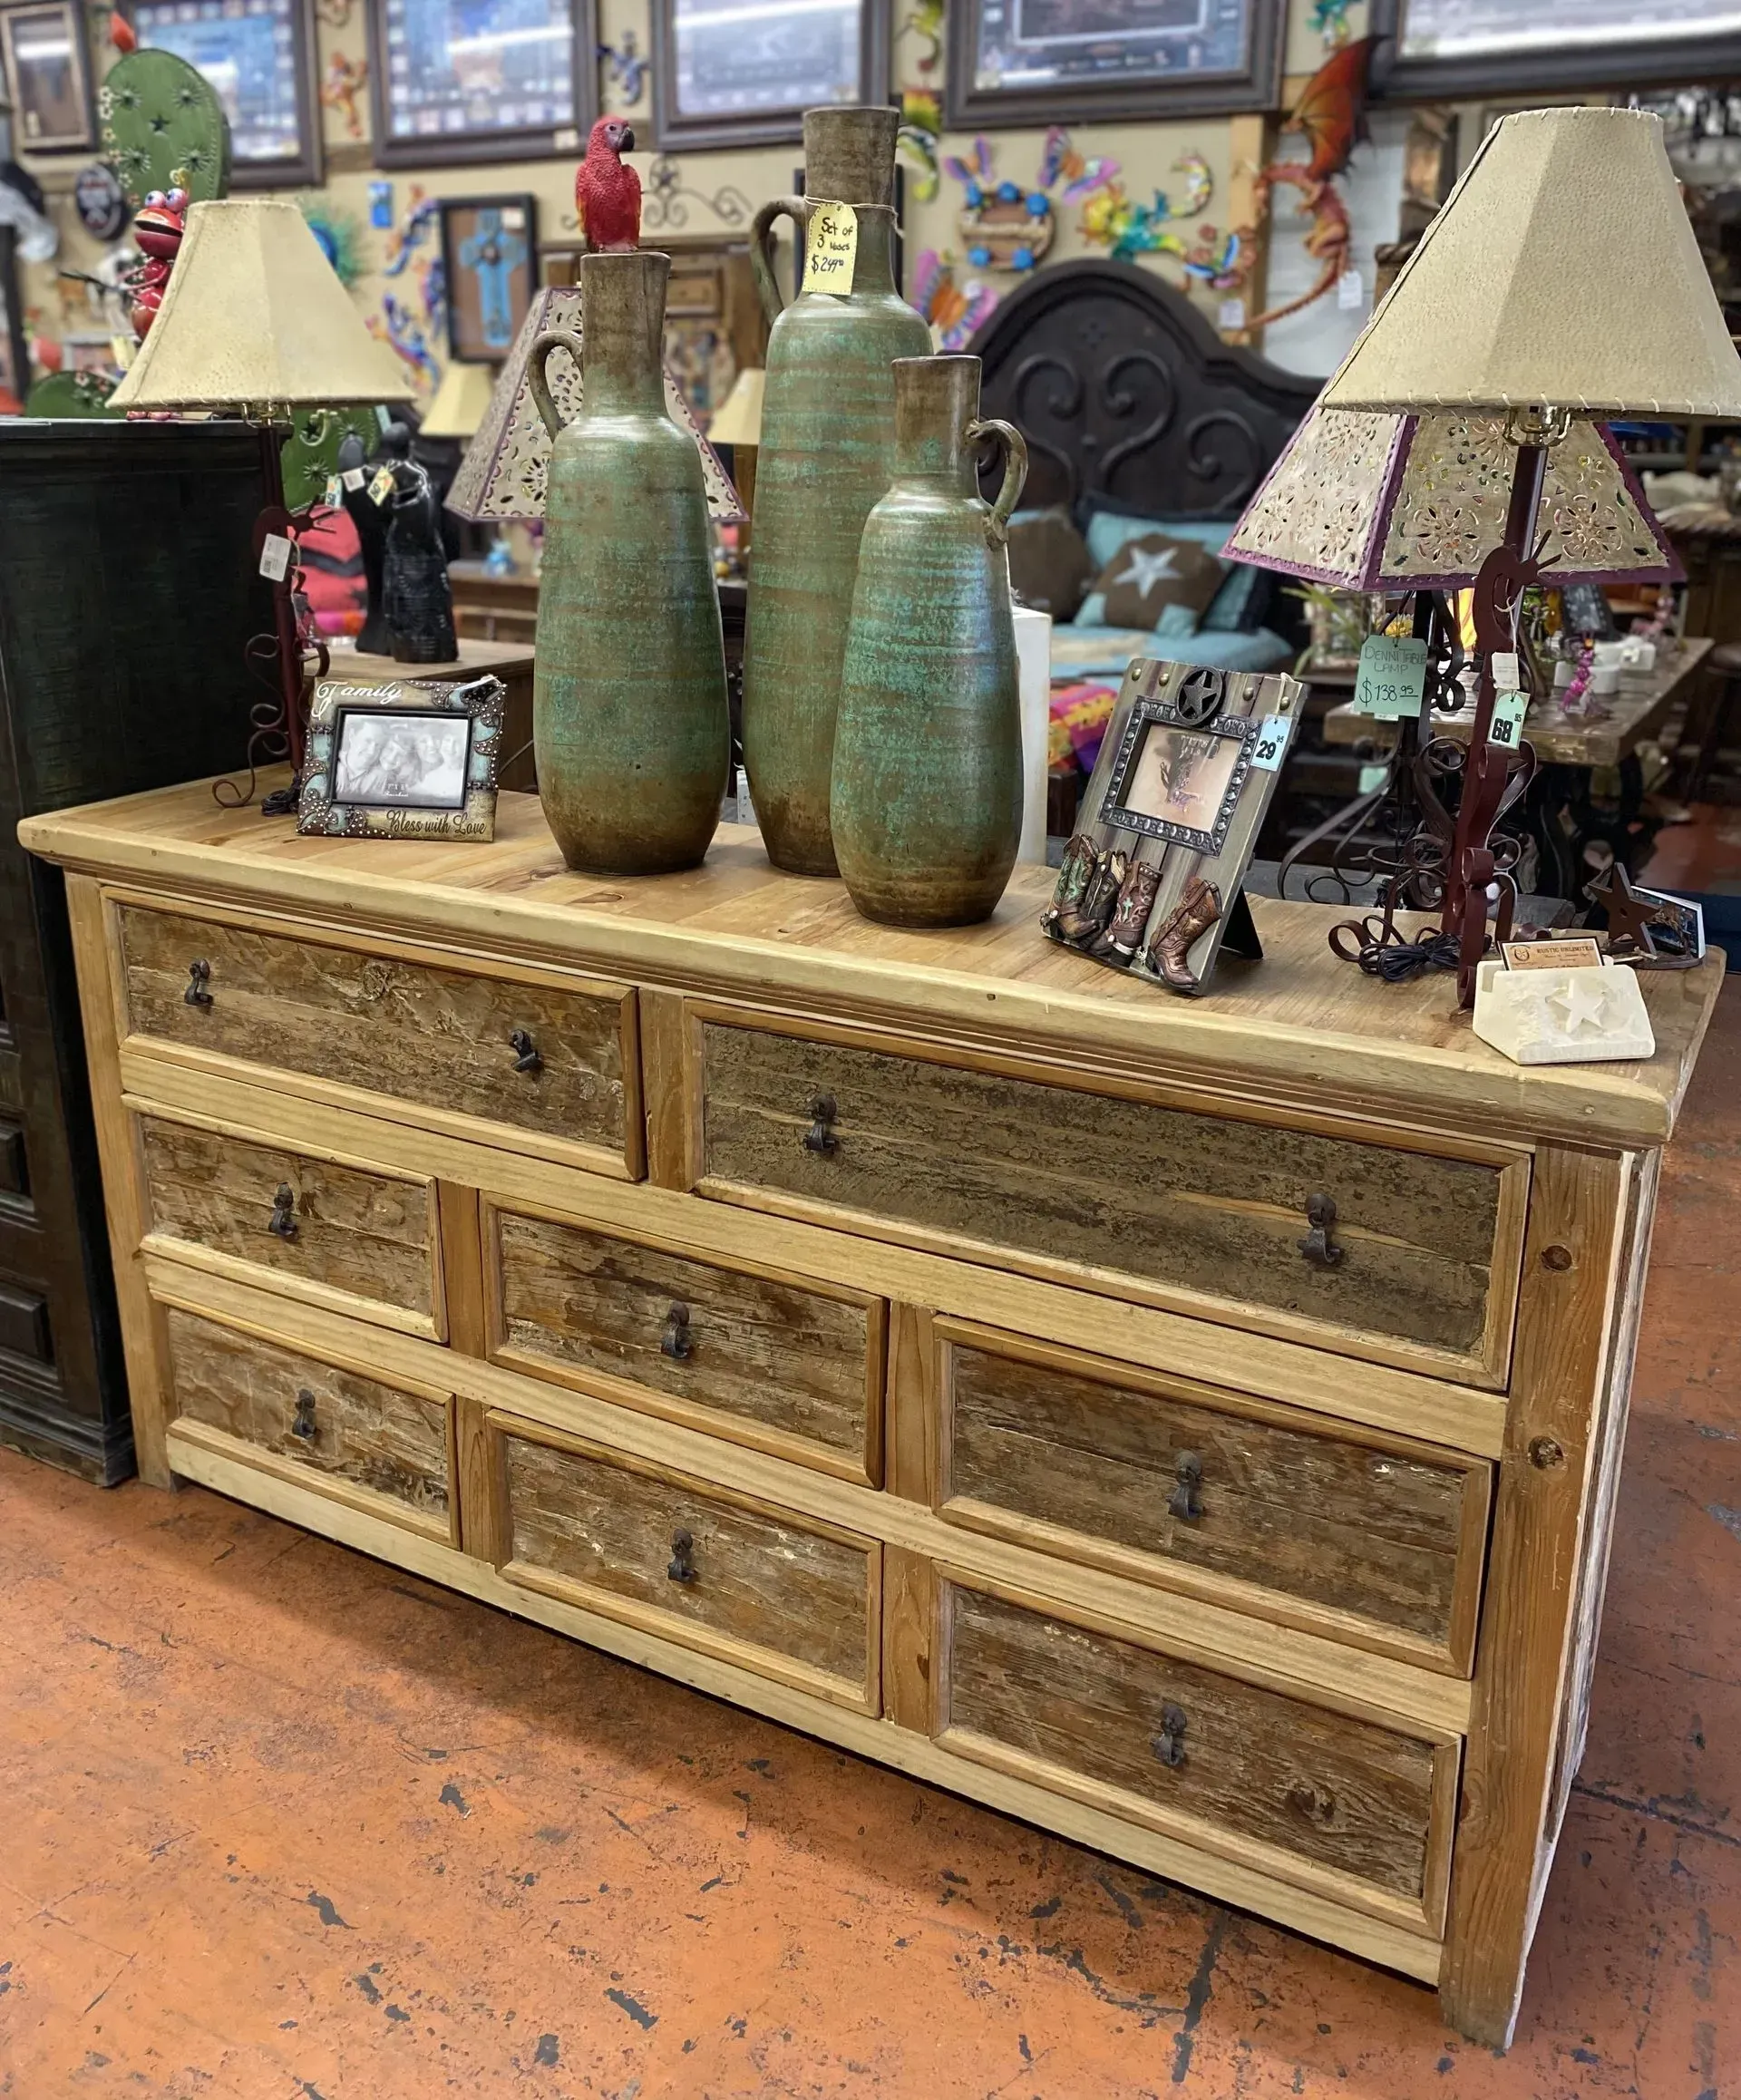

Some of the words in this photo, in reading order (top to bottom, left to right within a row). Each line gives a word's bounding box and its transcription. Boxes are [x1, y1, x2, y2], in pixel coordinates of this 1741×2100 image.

[822, 217, 838, 236] Set
[817, 234, 825, 248] 3
[1374, 661, 1408, 675] LAMP
[311, 681, 402, 720] Family
[1492, 717, 1513, 743] 68
[1256, 740, 1277, 760] 29
[386, 810, 423, 835] Bless
[424, 815, 450, 833] with
[452, 813, 487, 835] Love
